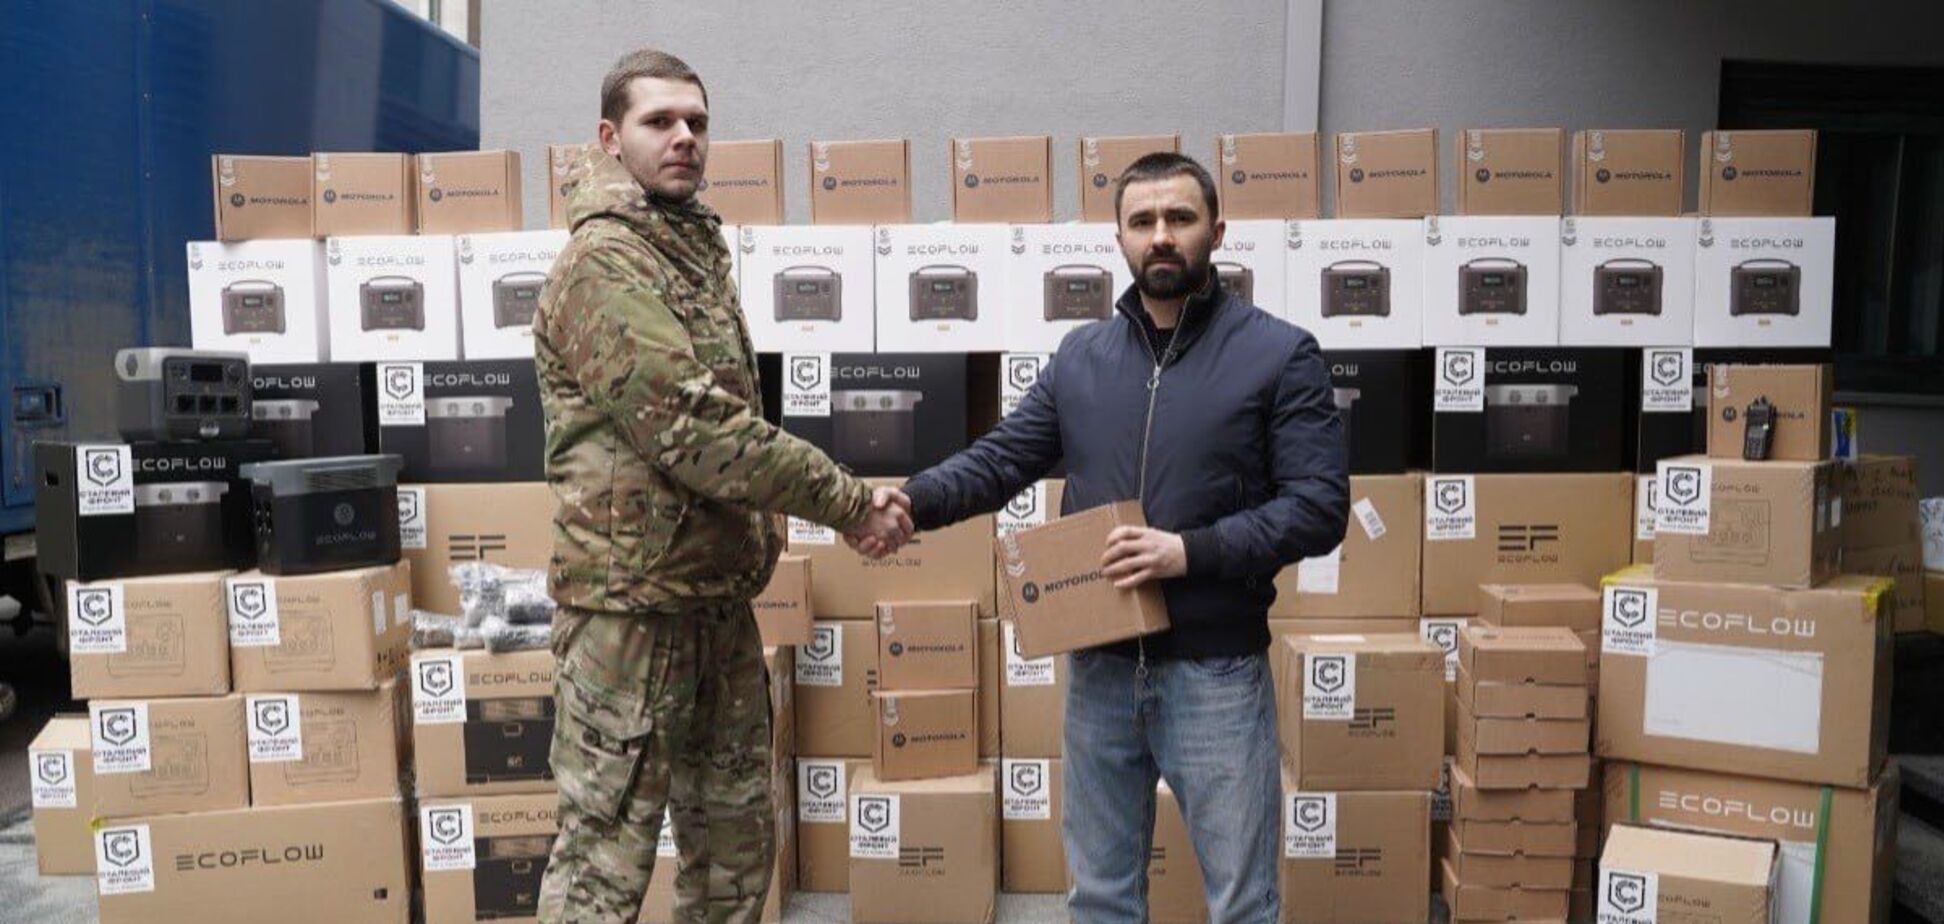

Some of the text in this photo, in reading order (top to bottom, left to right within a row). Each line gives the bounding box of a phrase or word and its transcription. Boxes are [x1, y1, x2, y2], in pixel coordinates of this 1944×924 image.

[1320, 239, 1392, 250] ECOFLOW
[1457, 237, 1531, 248] ECOFLOW
[1593, 238, 1667, 248] ECOFLOW
[1730, 238, 1804, 248] ECOFLOW
[773, 245, 844, 255] ECOFLOW
[907, 245, 979, 255] ECOFLOW
[253, 376, 316, 390] OFLOW
[1044, 568, 1105, 593] MOTOROL
[1658, 607, 1815, 638] ECOFLOW
[469, 671, 552, 685] ECOFLOW
[1658, 789, 1815, 829] ECOFLOW
[176, 843, 324, 872] ECOFLOW
